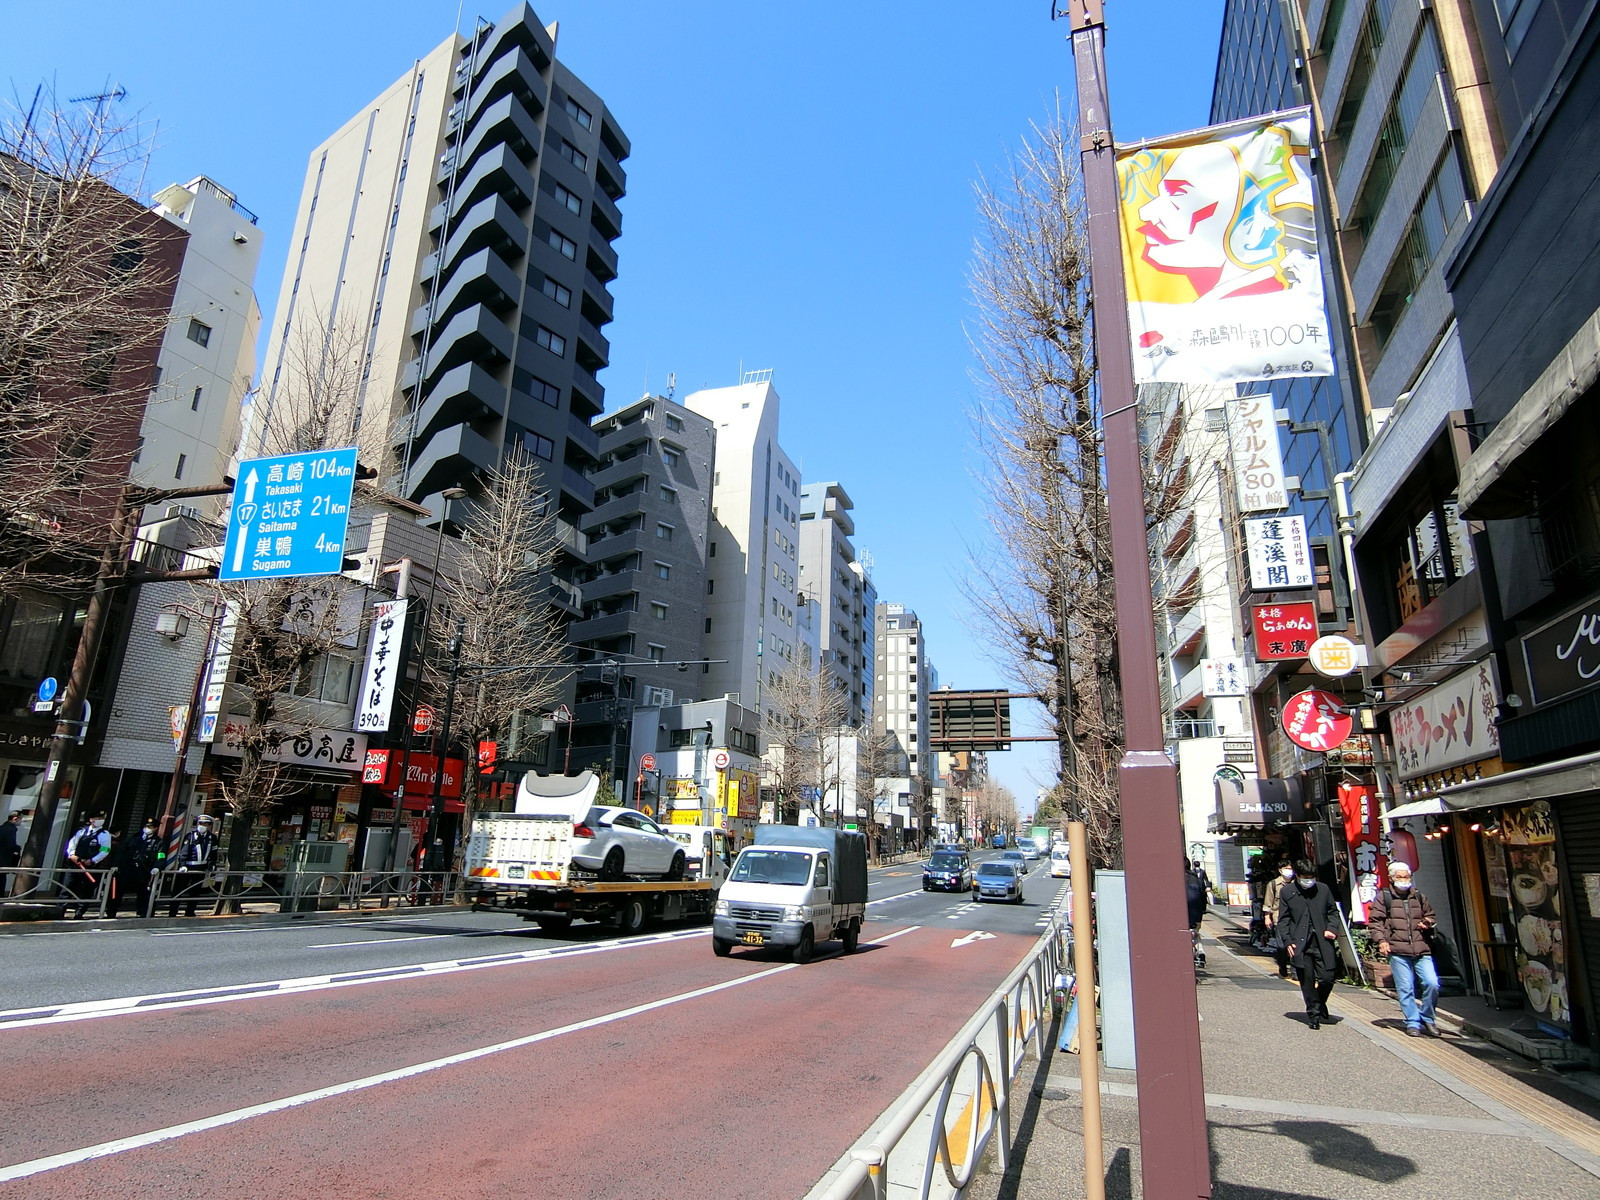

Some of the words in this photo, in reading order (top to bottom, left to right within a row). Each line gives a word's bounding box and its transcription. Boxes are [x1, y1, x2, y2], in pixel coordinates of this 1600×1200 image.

[267, 463, 304, 483] 高崎
[265, 482, 303, 496] Takasaki
[241, 506, 253, 520] 17
[261, 498, 303, 520] さいたま
[258, 521, 297, 534] Saitama
[254, 535, 292, 558] 巣鴨
[1290, 518, 1305, 566] 本格四川料理
[252, 558, 291, 572] Sugamo
[1296, 575, 1309, 584] 2F
[1257, 607, 1283, 619] 本格
[369, 616, 395, 709] 中華そば
[1318, 641, 1353, 670] 歯
[364, 768, 382, 782] 飲み
